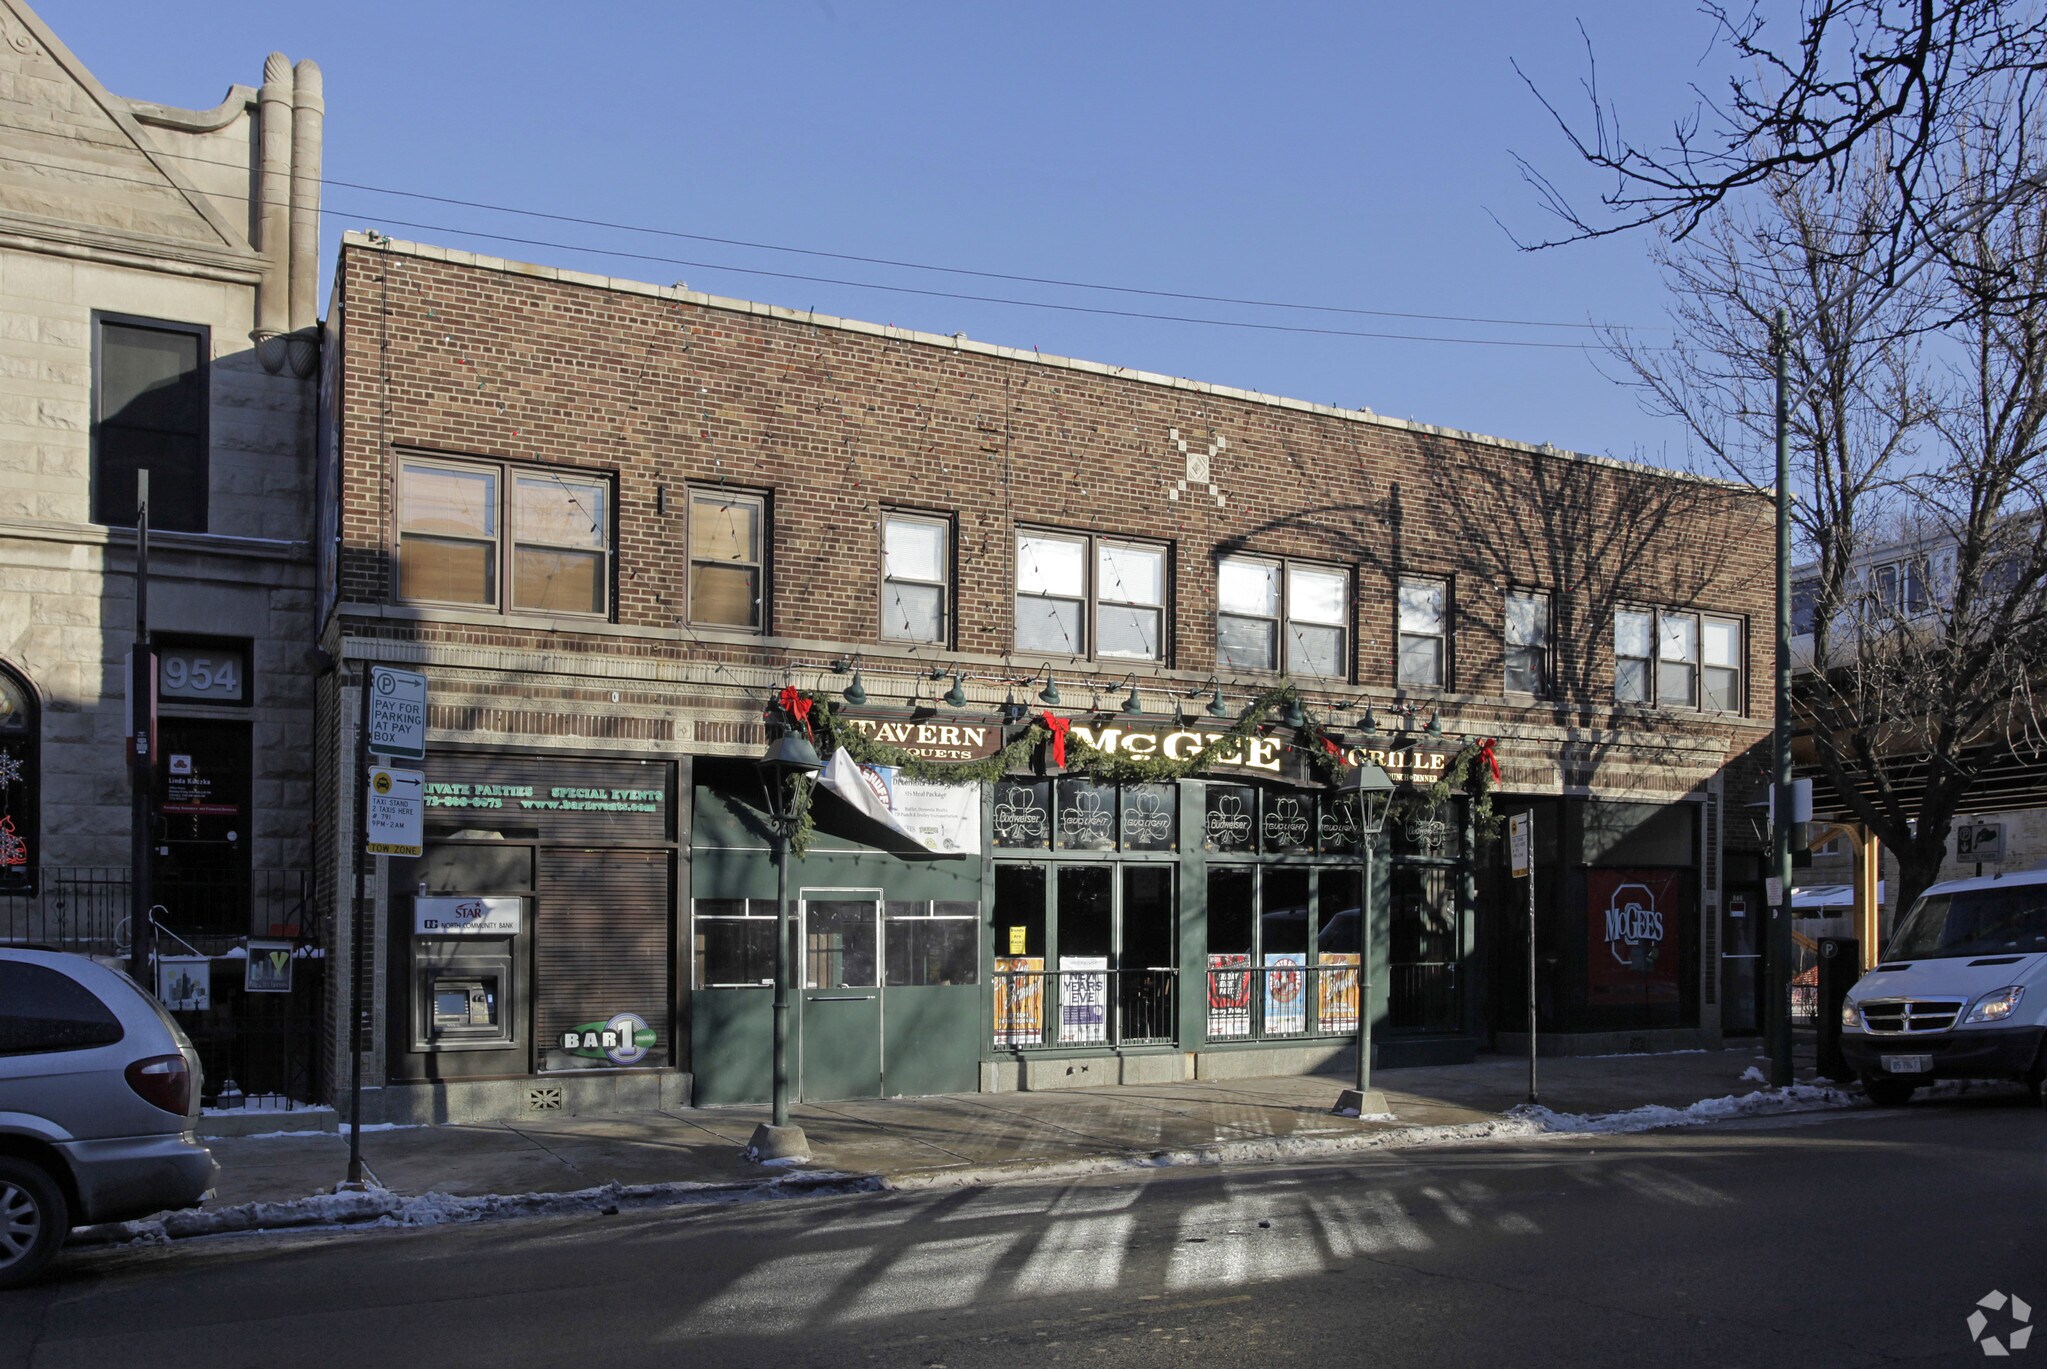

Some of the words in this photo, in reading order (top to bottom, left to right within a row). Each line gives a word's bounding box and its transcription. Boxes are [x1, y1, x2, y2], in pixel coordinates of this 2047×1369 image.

[166, 657, 237, 692] 954
[375, 699, 396, 711] PAY
[399, 703, 420, 714] FOR
[374, 710, 422, 725] PARKING
[374, 721, 389, 731] AT
[392, 723, 413, 734] PAY
[374, 731, 396, 742] BOX
[848, 720, 987, 747] TAVERN
[1347, 748, 1445, 769] GRILLE
[168, 777, 186, 785] Linda
[1412, 773, 1438, 783] DINNER
[475, 785, 534, 797] PARTIES
[551, 787, 608, 800] SPECIAL
[611, 789, 665, 801] EVENTS
[926, 791, 946, 800] Package
[390, 800, 409, 808] STAND
[379, 806, 396, 814] TAXIS
[1211, 819, 1248, 830] Budweiser
[1284, 823, 1306, 831] LIGHT
[372, 844, 390, 852] TOW
[394, 845, 418, 855] ZONE
[455, 908, 482, 919] STAR
[441, 922, 461, 930] NORTH
[463, 922, 497, 930] COMMUNITY
[1064, 981, 1103, 992] YEARS
[1071, 992, 1095, 1003] EVE
